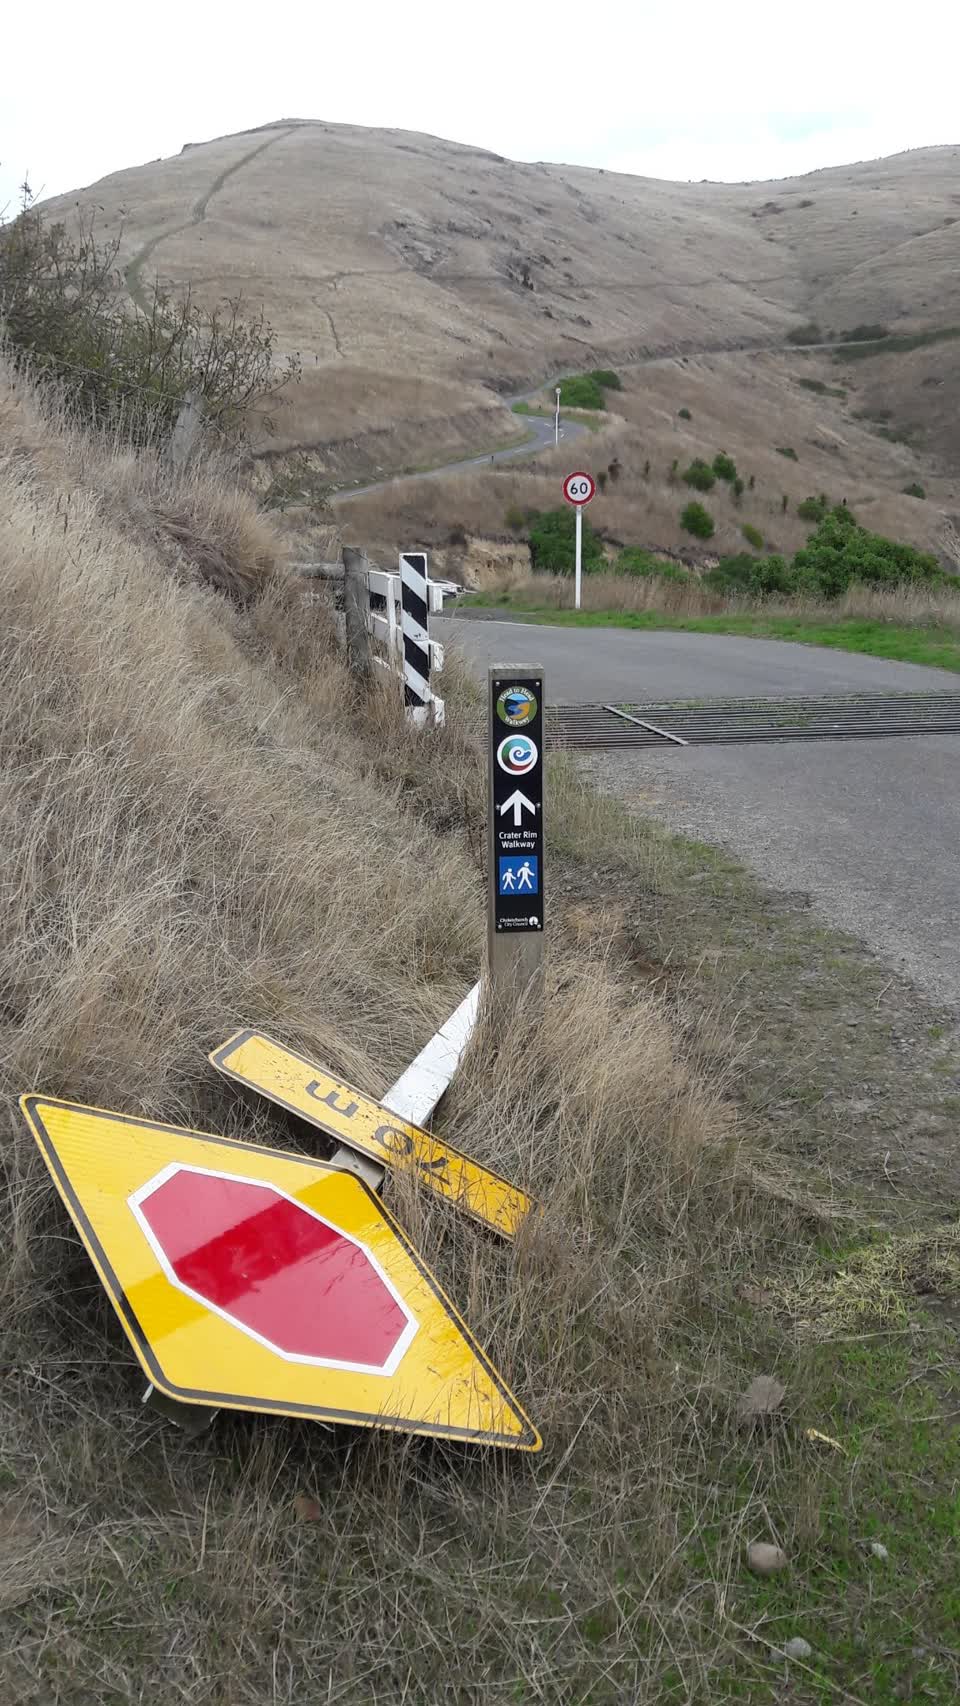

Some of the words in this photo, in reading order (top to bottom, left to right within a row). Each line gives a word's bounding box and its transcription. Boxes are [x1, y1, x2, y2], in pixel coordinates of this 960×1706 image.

[570, 482, 588, 495] 60
[499, 688, 514, 702] Head
[520, 688, 535, 702] Head
[505, 715, 530, 725] Walkway
[499, 831, 521, 839] Crater
[523, 830, 538, 839] Rim
[501, 840, 536, 849] Walkway
[305, 1079, 359, 1118] m
[374, 1125, 451, 1185] 70
